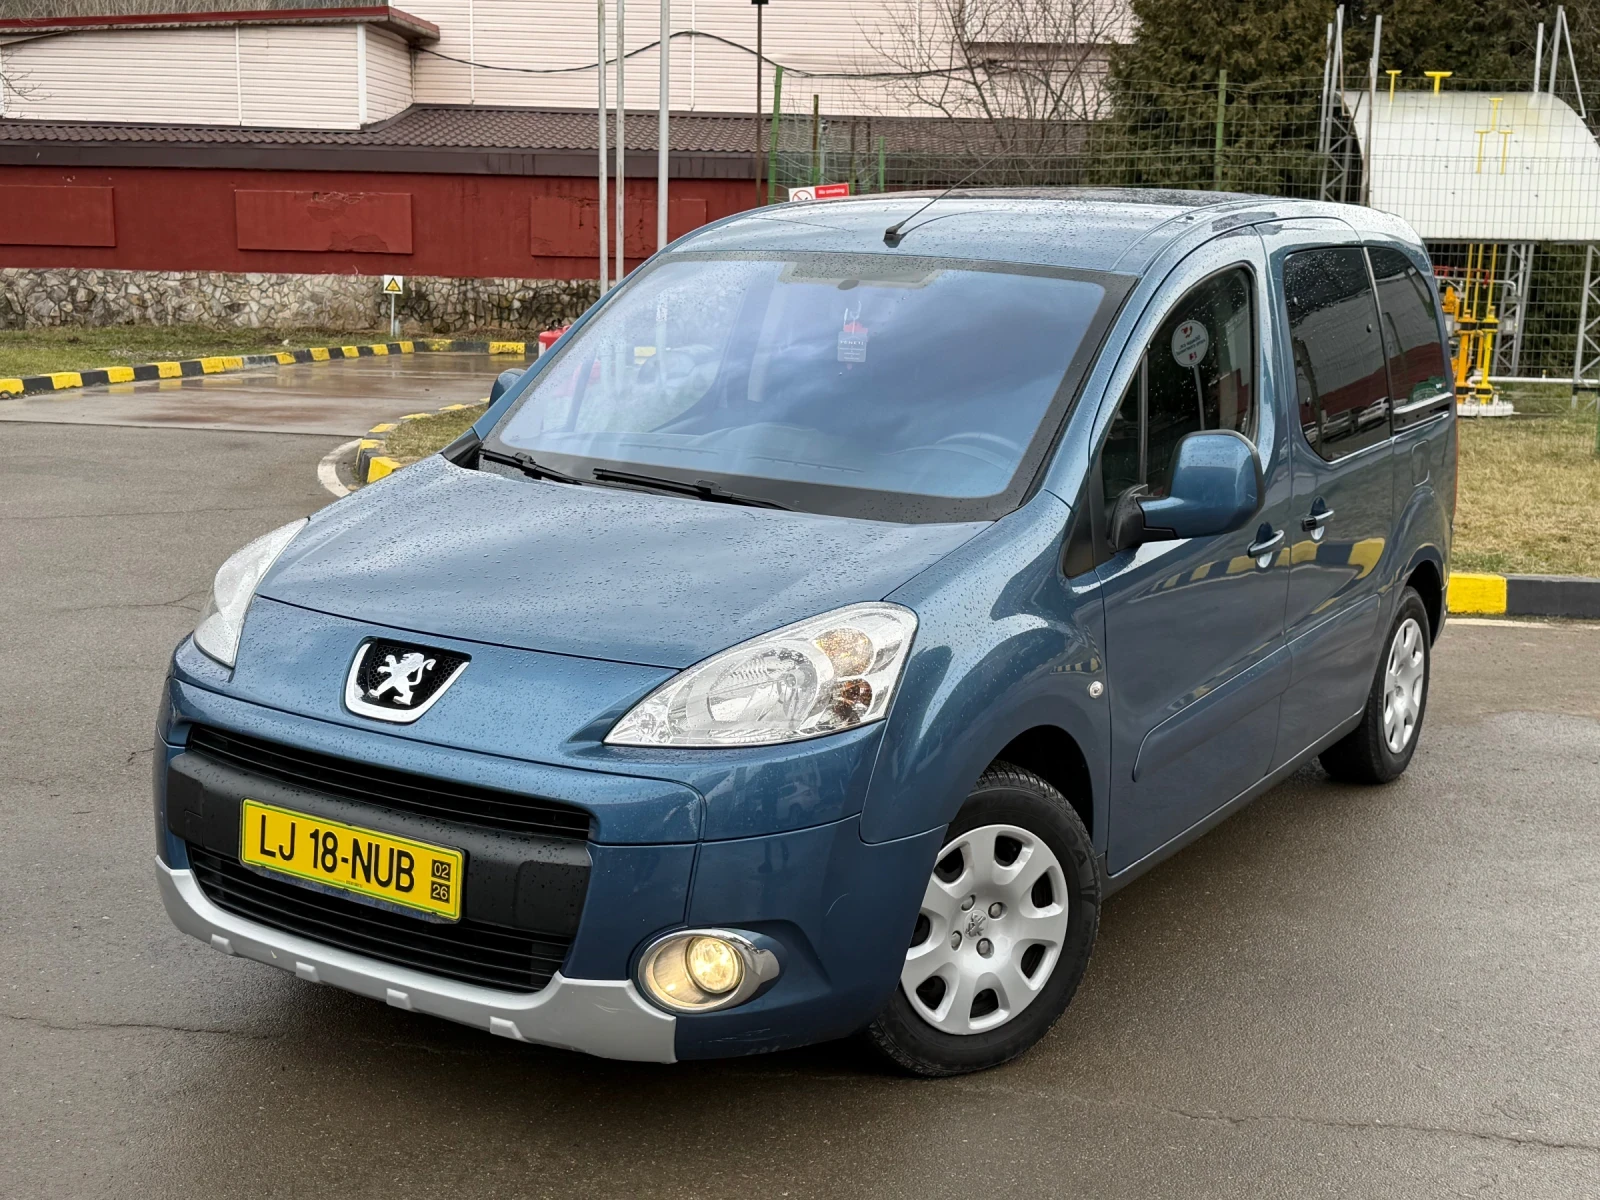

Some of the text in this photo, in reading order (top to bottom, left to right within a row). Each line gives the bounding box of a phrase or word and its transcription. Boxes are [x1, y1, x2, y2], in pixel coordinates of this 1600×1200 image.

[260, 814, 415, 893] LJ 18-NUB
[434, 862, 449, 878] 02
[432, 884, 448, 900] 26
